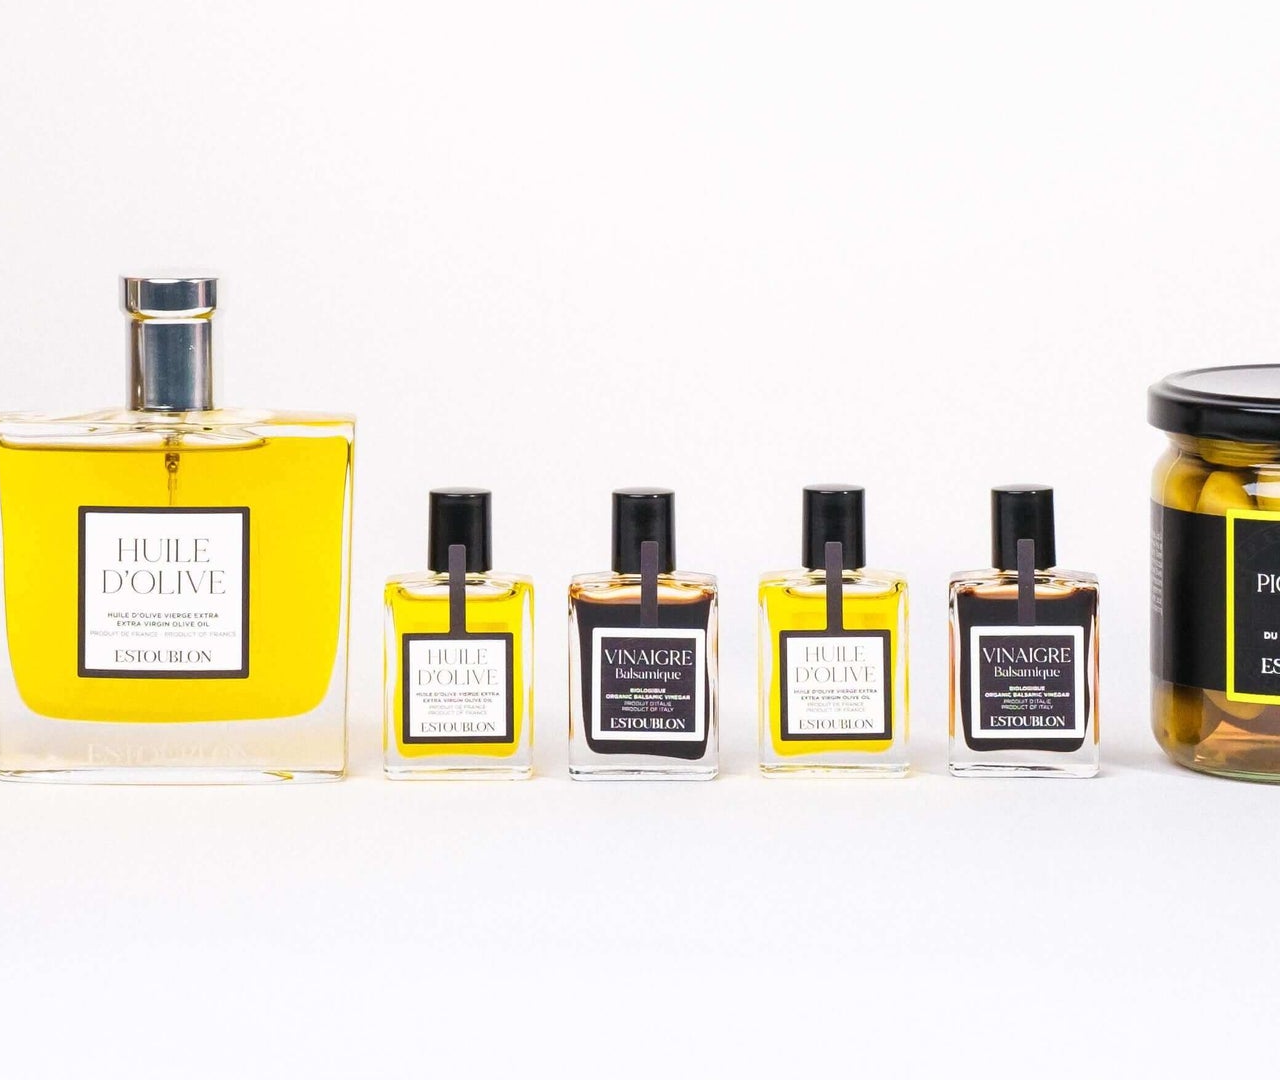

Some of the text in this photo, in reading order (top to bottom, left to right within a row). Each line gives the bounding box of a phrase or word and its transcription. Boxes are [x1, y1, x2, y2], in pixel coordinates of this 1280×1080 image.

[117, 538, 210, 563] HUILE
[102, 570, 226, 595] D'OLIVE
[1264, 632, 1277, 640] DU
[115, 650, 212, 663] ESTOUBLON
[429, 648, 488, 664] HUILE
[604, 649, 693, 665] VINAIGRE
[806, 646, 865, 662] HUILE
[983, 647, 1071, 663] VINAIGRE
[418, 669, 498, 685] D'OLIVE
[616, 668, 681, 682] Balsamique
[796, 666, 876, 682] D'OLIVE
[994, 666, 1060, 680] Balsamique
[422, 722, 495, 732] ESTOUBLON
[611, 718, 685, 729] ESTOUBLON
[800, 720, 873, 729] ESTOUBLON
[991, 716, 1065, 727] ESTOUBLON
